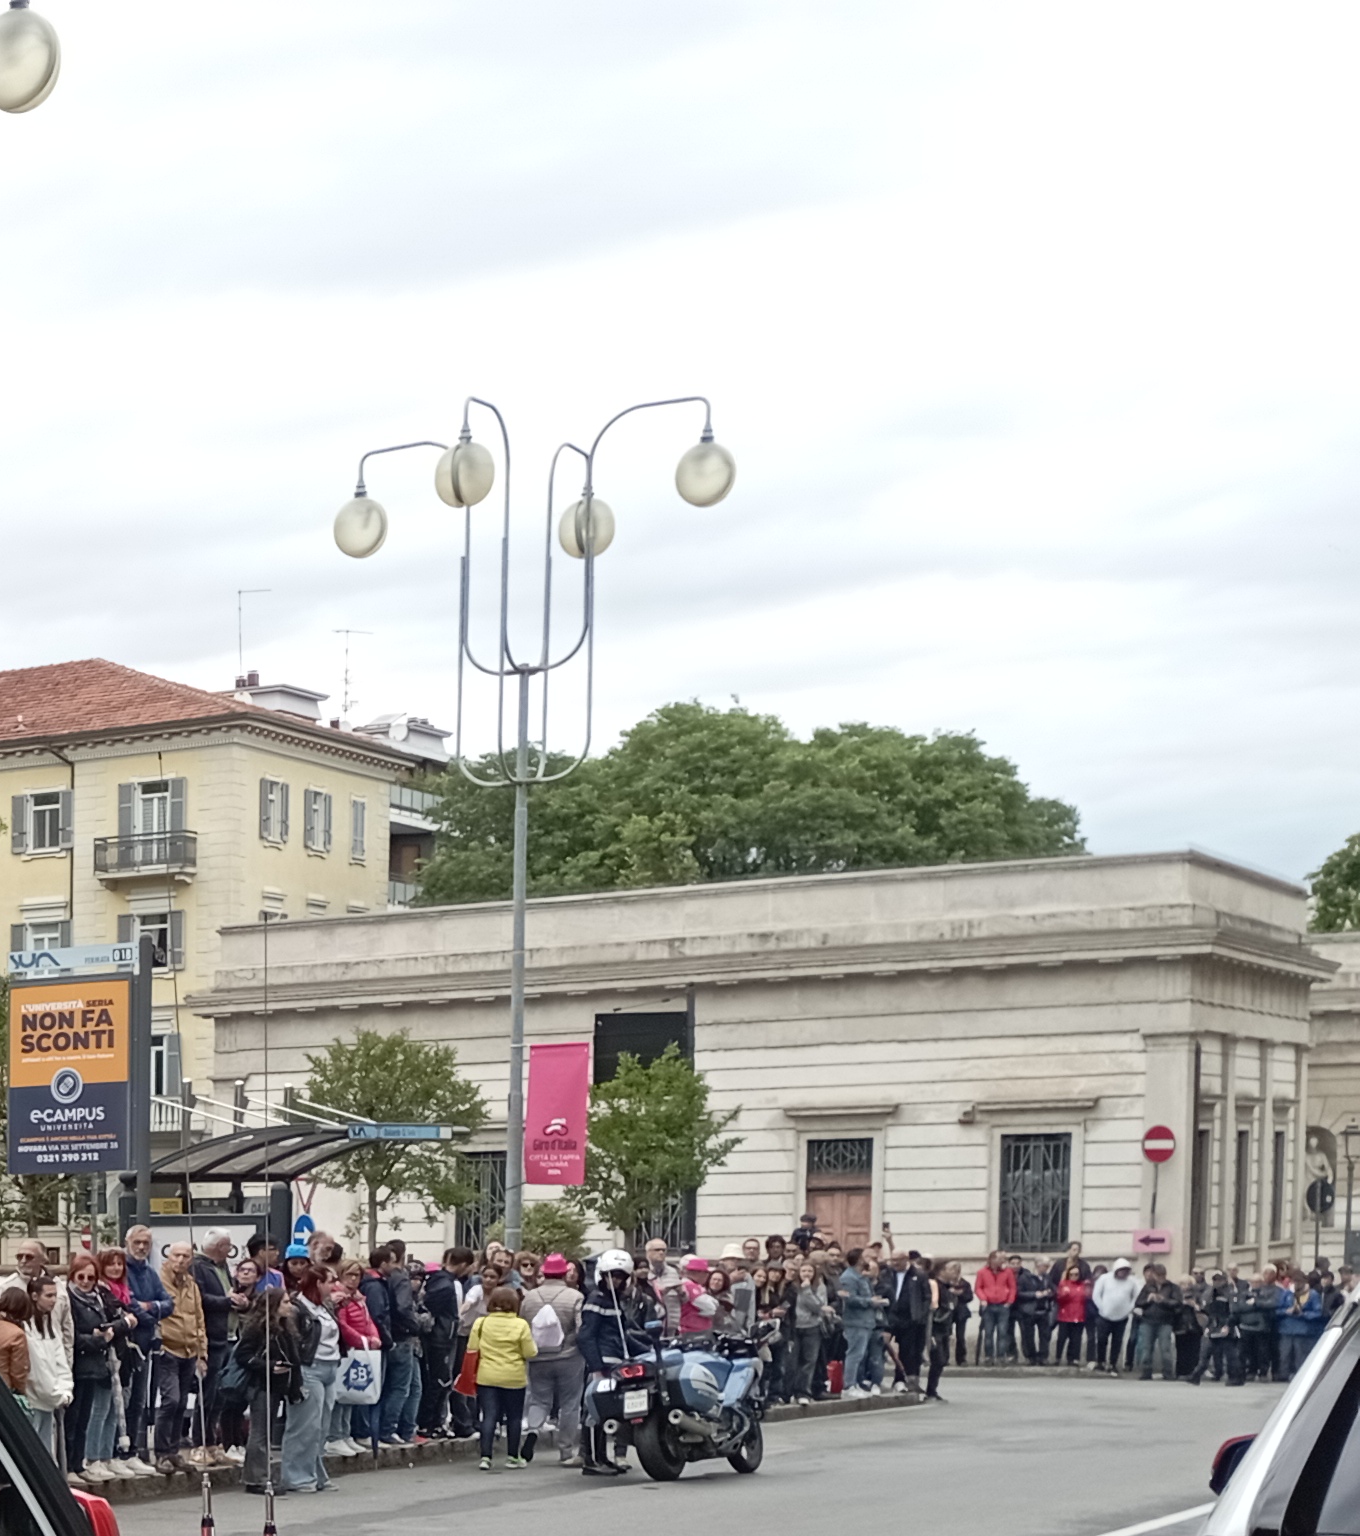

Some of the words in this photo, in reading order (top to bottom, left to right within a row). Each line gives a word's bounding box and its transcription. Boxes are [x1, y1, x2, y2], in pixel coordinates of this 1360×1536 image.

[21, 1011, 75, 1032] NON
[81, 1008, 114, 1028] FA
[21, 1029, 115, 1053] SCONTI
